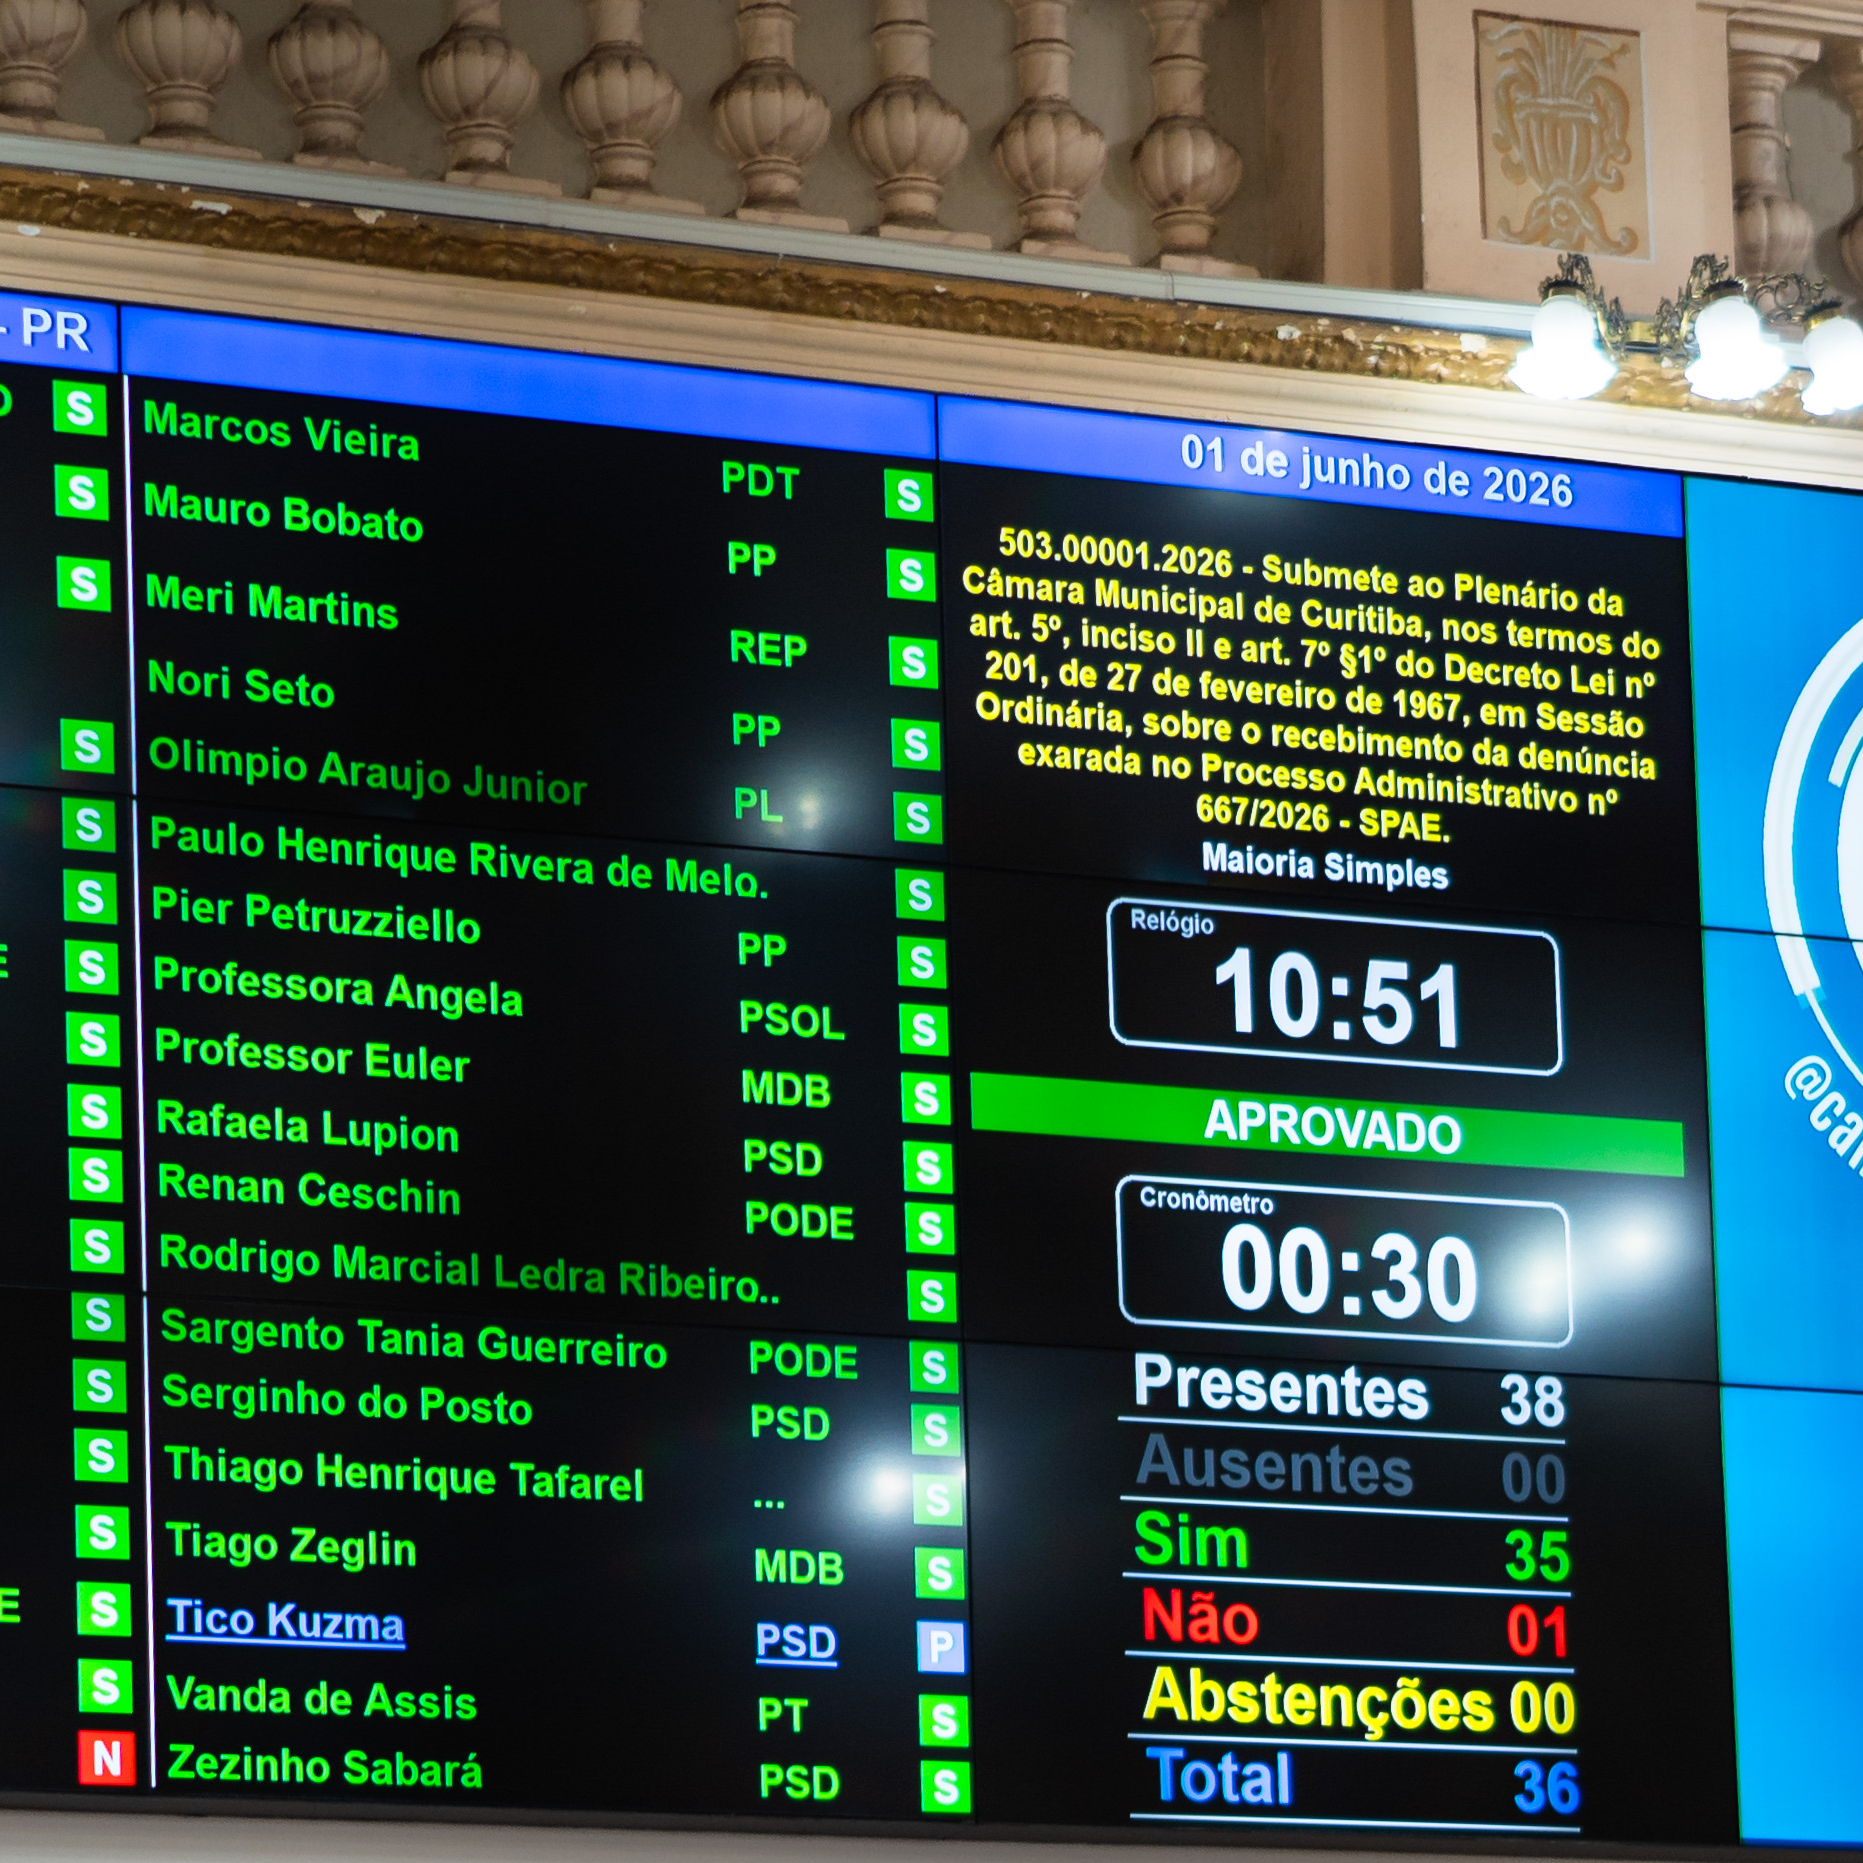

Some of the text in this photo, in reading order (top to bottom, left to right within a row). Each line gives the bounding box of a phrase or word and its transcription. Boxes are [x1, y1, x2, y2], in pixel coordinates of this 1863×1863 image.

[22, 307, 88, 351] PR
[67, 391, 93, 425] S
[145, 400, 419, 460] Marcos Vieira
[723, 461, 799, 499] PDT
[898, 479, 921, 512] S
[1182, 434, 1572, 507] 01 de junho de 2026
[1000, 527, 1232, 577] 503.00001.2026
[1262, 554, 1398, 594] Submete
[1408, 575, 1444, 598] ao
[1455, 573, 1578, 611] Plenário
[1588, 588, 1623, 616] da
[963, 566, 1660, 659] Câmara Municipal de Curitiba, nos termos do
[970, 611, 1020, 640] art.
[1082, 618, 1175, 654] inciso
[1187, 629, 1203, 657] II
[1214, 638, 1231, 659] e
[1241, 637, 1290, 665] art.
[1396, 649, 1434, 678] do
[1445, 653, 1561, 690] Decreto
[1571, 665, 1614, 696] Lei
[986, 650, 1644, 738] 201, de 27 de fevereiro de 1967, em Sessão
[75, 730, 100, 763] S
[976, 691, 1655, 780] Ordinária, sobre o recebimento da denúncia
[150, 737, 587, 805] Olimpio Araujo Junior
[1018, 743, 1141, 775] exarada
[1153, 755, 1191, 779] no
[1202, 753, 1346, 792] Processo
[1355, 766, 1577, 815] Administrativo
[735, 788, 783, 823] PL
[1197, 794, 1329, 832] 667/2026
[1360, 808, 1449, 842] SPAE.
[1203, 842, 1449, 892] Maioria Simples
[1132, 909, 1214, 938] Relógio
[1217, 948, 1456, 1048] 10:51
[1205, 1100, 1461, 1154] APROVADO
[83, 1158, 109, 1192] S
[1141, 1187, 1273, 1214] Cronômetro
[161, 1234, 779, 1304] Rodrigo Marcial Ledra Ribeiro..
[1223, 1224, 1478, 1322] 00:30
[1135, 1352, 1565, 1427] Presentes 38
[1137, 1434, 1565, 1504] Ausentes 00
[1135, 1511, 1569, 1581] Sim 35
[166, 1598, 404, 1642] Tico Kuzma
[756, 1623, 837, 1659] PSD
[931, 1631, 952, 1663] P
[1144, 1588, 1565, 1657] Não 01
[1143, 1666, 1574, 1740] Abstenções 00
[94, 1741, 120, 1776] N
[168, 1744, 482, 1787] Zezinho Sabará
[761, 1764, 839, 1799] PSD
[1146, 1748, 1580, 1814] Total 36
[934, 1770, 958, 1804] S
